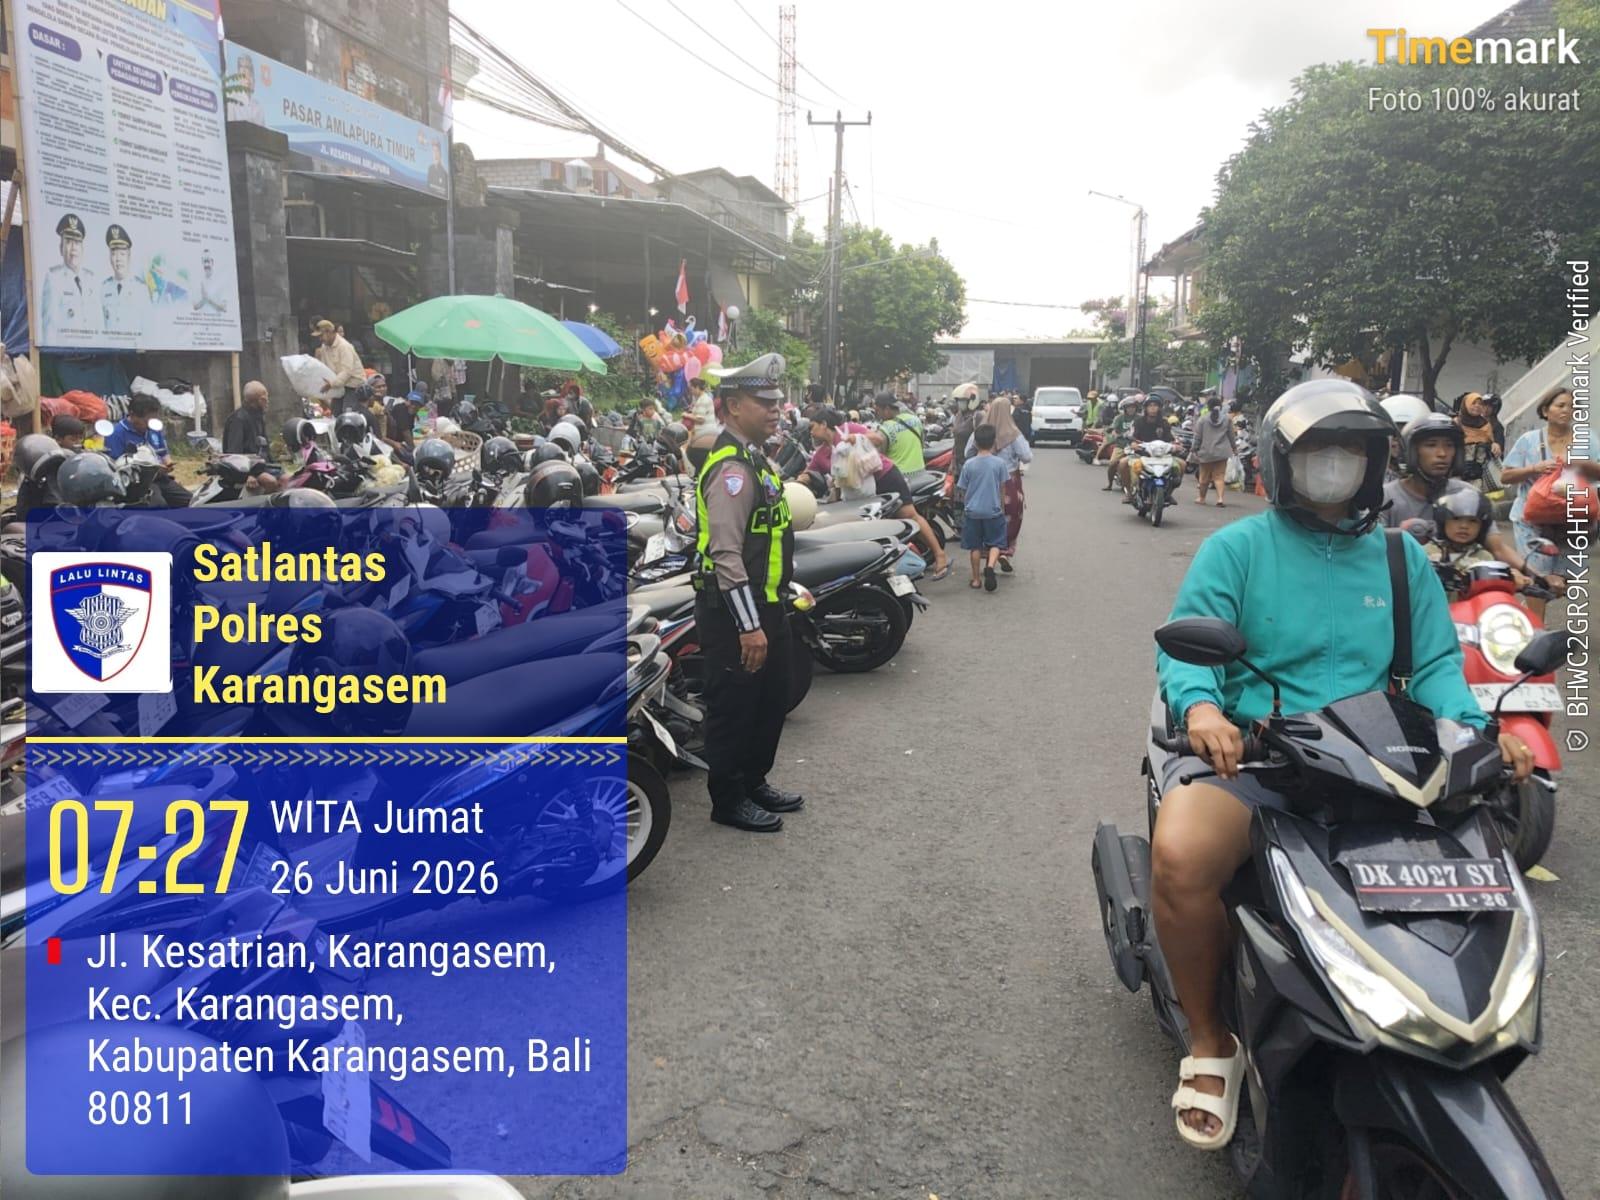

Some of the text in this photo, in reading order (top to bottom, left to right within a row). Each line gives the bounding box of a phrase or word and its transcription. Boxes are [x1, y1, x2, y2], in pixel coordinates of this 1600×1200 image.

[32, 28, 61, 50] DASAR
[282, 97, 322, 128] PASAR
[325, 114, 384, 151] AMLAPURA
[386, 138, 417, 162] TIMUR
[1385, 745, 1431, 755] HONDA
[1355, 863, 1500, 888] DK 4027 SY
